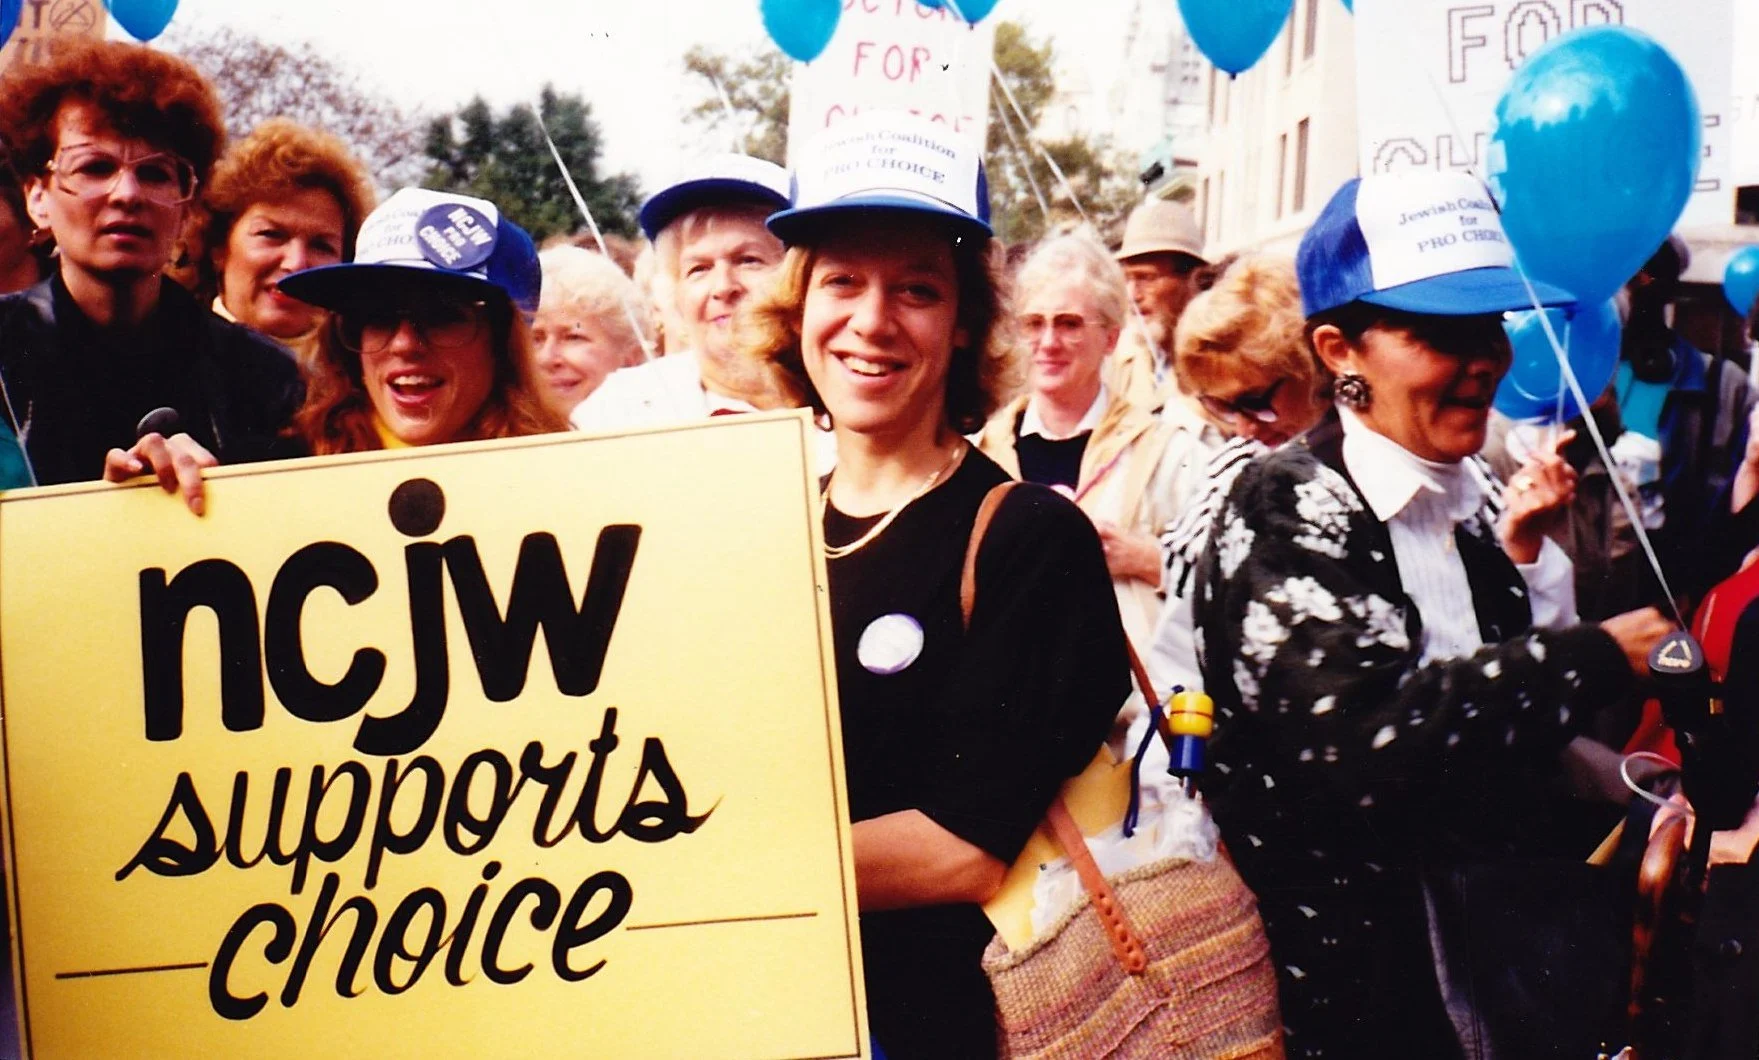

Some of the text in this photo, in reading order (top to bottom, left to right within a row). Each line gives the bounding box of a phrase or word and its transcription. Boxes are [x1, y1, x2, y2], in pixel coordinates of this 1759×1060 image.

[853, 42, 931, 82] FOR
[871, 145, 897, 154] for
[878, 130, 956, 159] Coalition
[867, 158, 945, 183] CHOICE
[448, 207, 493, 246] NCJW
[1398, 201, 1457, 226] Jewish
[1459, 215, 1478, 226] for
[419, 225, 462, 265] CHOICE
[1417, 233, 1457, 252] PRO
[139, 478, 642, 756] ncjw
[115, 707, 724, 894] supports
[207, 861, 633, 1020] choice
